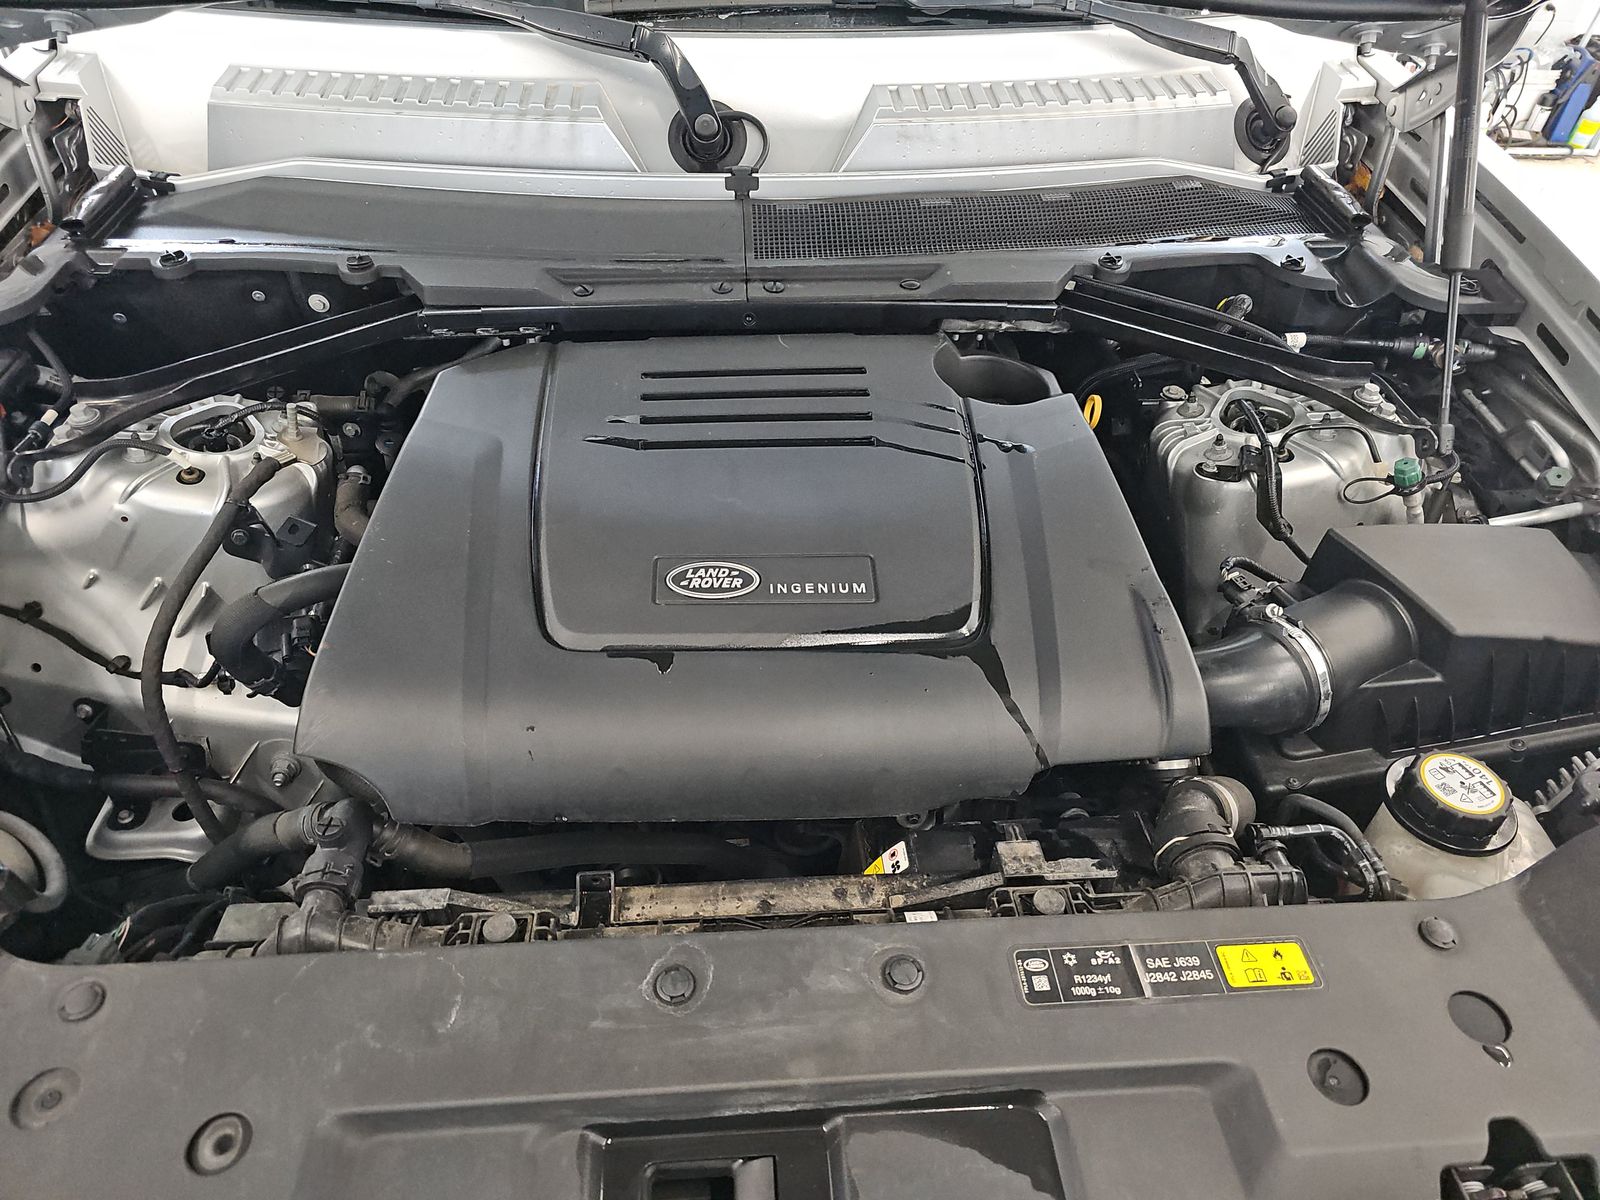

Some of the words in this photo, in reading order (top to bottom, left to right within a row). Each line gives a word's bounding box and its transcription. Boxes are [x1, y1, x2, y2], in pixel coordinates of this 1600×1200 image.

[685, 568, 730, 578] LAND
[688, 577, 744, 589] ROVER
[769, 582, 867, 595] INGENIUM
[1145, 957, 1171, 969] SAE
[1173, 956, 1201, 968] J639
[1073, 973, 1113, 985] R1234yf
[1144, 971, 1179, 983] J2842
[1179, 969, 1214, 982] J2845
[1070, 986, 1097, 997] 1000g
